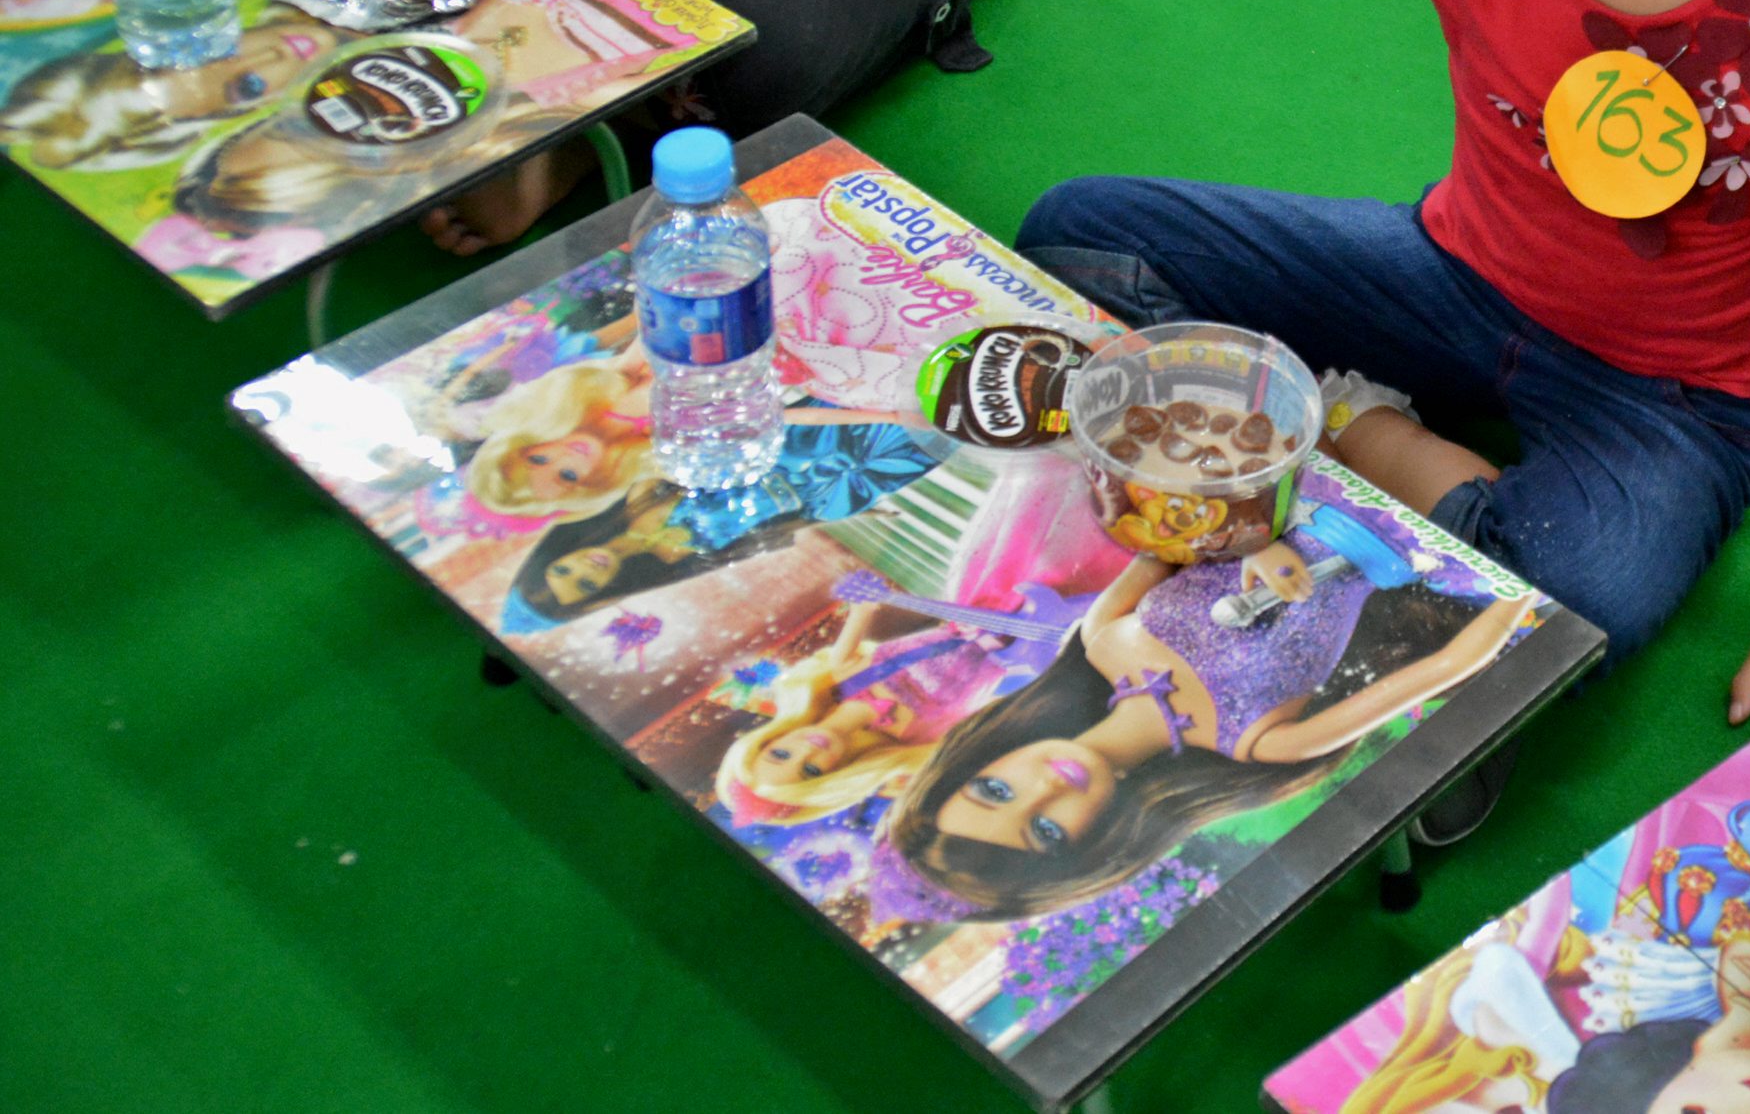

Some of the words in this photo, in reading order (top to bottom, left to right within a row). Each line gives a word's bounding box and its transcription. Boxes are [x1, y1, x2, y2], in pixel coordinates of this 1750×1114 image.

[1576, 70, 1693, 177] 163
[834, 173, 951, 256] Popstar
[859, 243, 978, 329] Barbie
[976, 336, 1021, 393] KRUNCH
[978, 393, 1021, 432] KOKO
[1315, 459, 1388, 512] About
[1398, 511, 1532, 598] Everything
